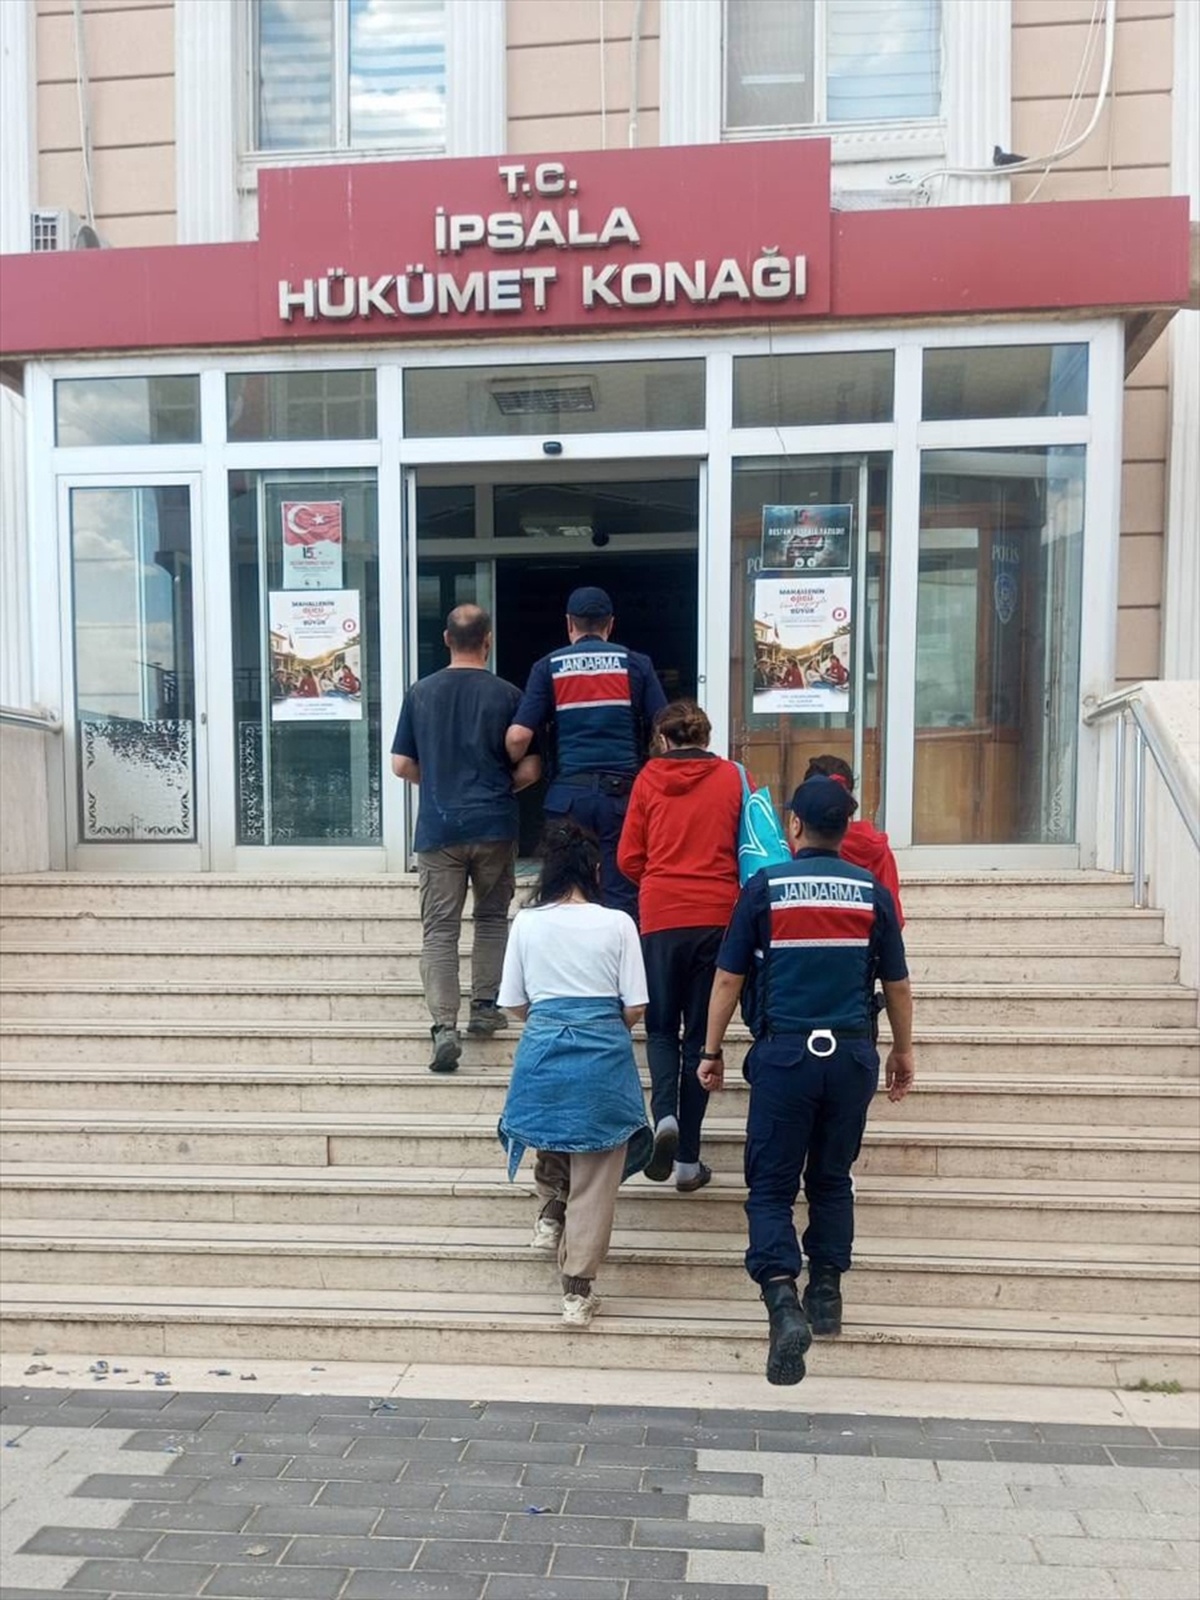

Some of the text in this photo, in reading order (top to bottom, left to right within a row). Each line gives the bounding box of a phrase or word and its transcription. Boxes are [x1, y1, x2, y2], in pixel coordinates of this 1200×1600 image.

[498, 162, 578, 197] T.C.
[435, 206, 641, 254] İPSALA
[278, 245, 807, 321] HÜKÜMET KONAĞI
[559, 656, 622, 673] JANDARMA
[780, 882, 863, 902] JANDARMA
